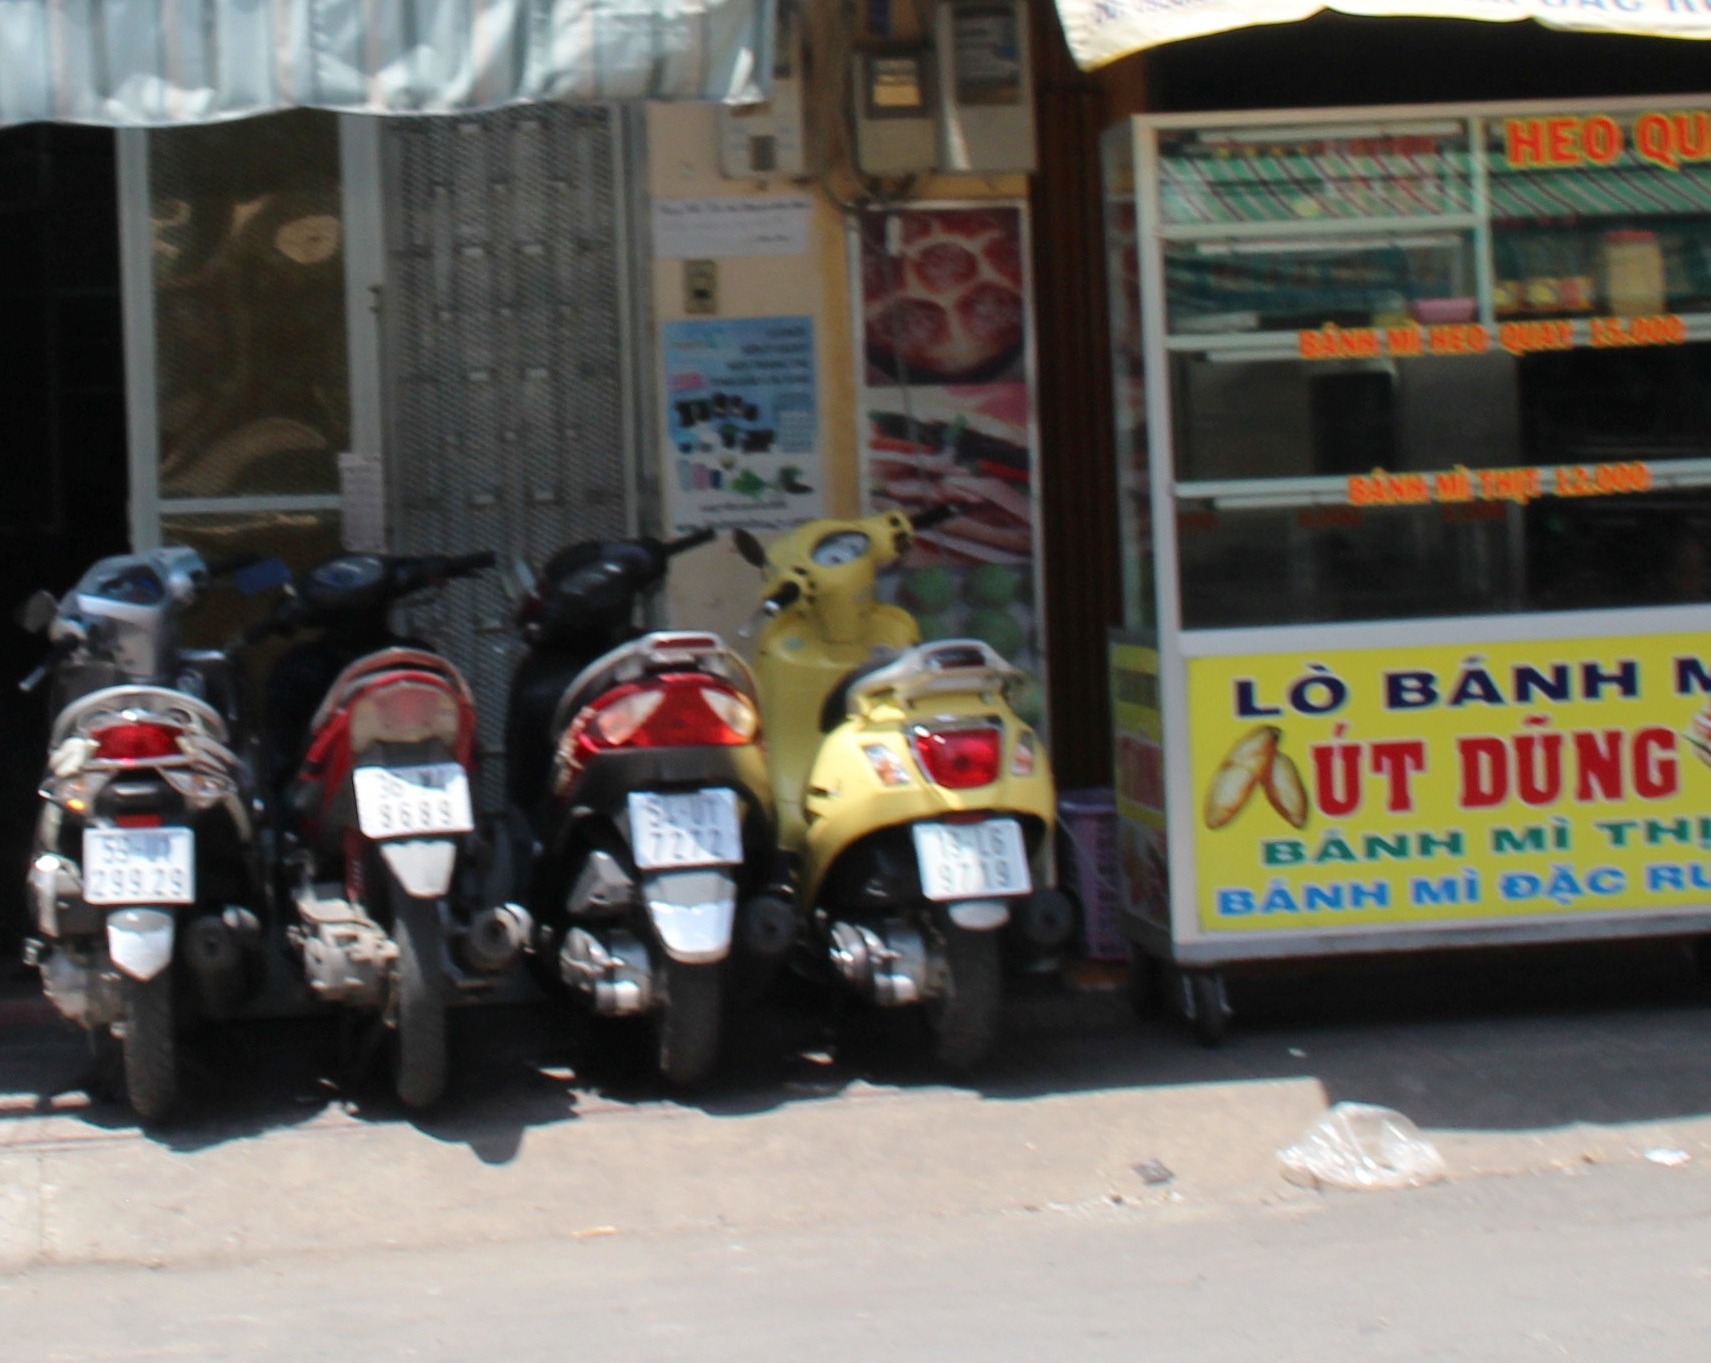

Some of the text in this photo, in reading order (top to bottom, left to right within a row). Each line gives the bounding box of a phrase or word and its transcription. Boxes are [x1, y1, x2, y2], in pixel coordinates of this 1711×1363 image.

[1504, 114, 1624, 169] HEO
[1348, 467, 1431, 506] BÁNH
[1233, 664, 1349, 718] LÒ
[1382, 656, 1640, 712] BÁNH
[1311, 715, 1680, 817] ÚT DŨNG
[1262, 829, 1466, 867] BÁNH
[1491, 816, 1573, 855] MÌ
[1216, 880, 1390, 918] BÁNH
[1409, 866, 1481, 907] MÌ
[1500, 862, 1627, 908] ĐẶC
